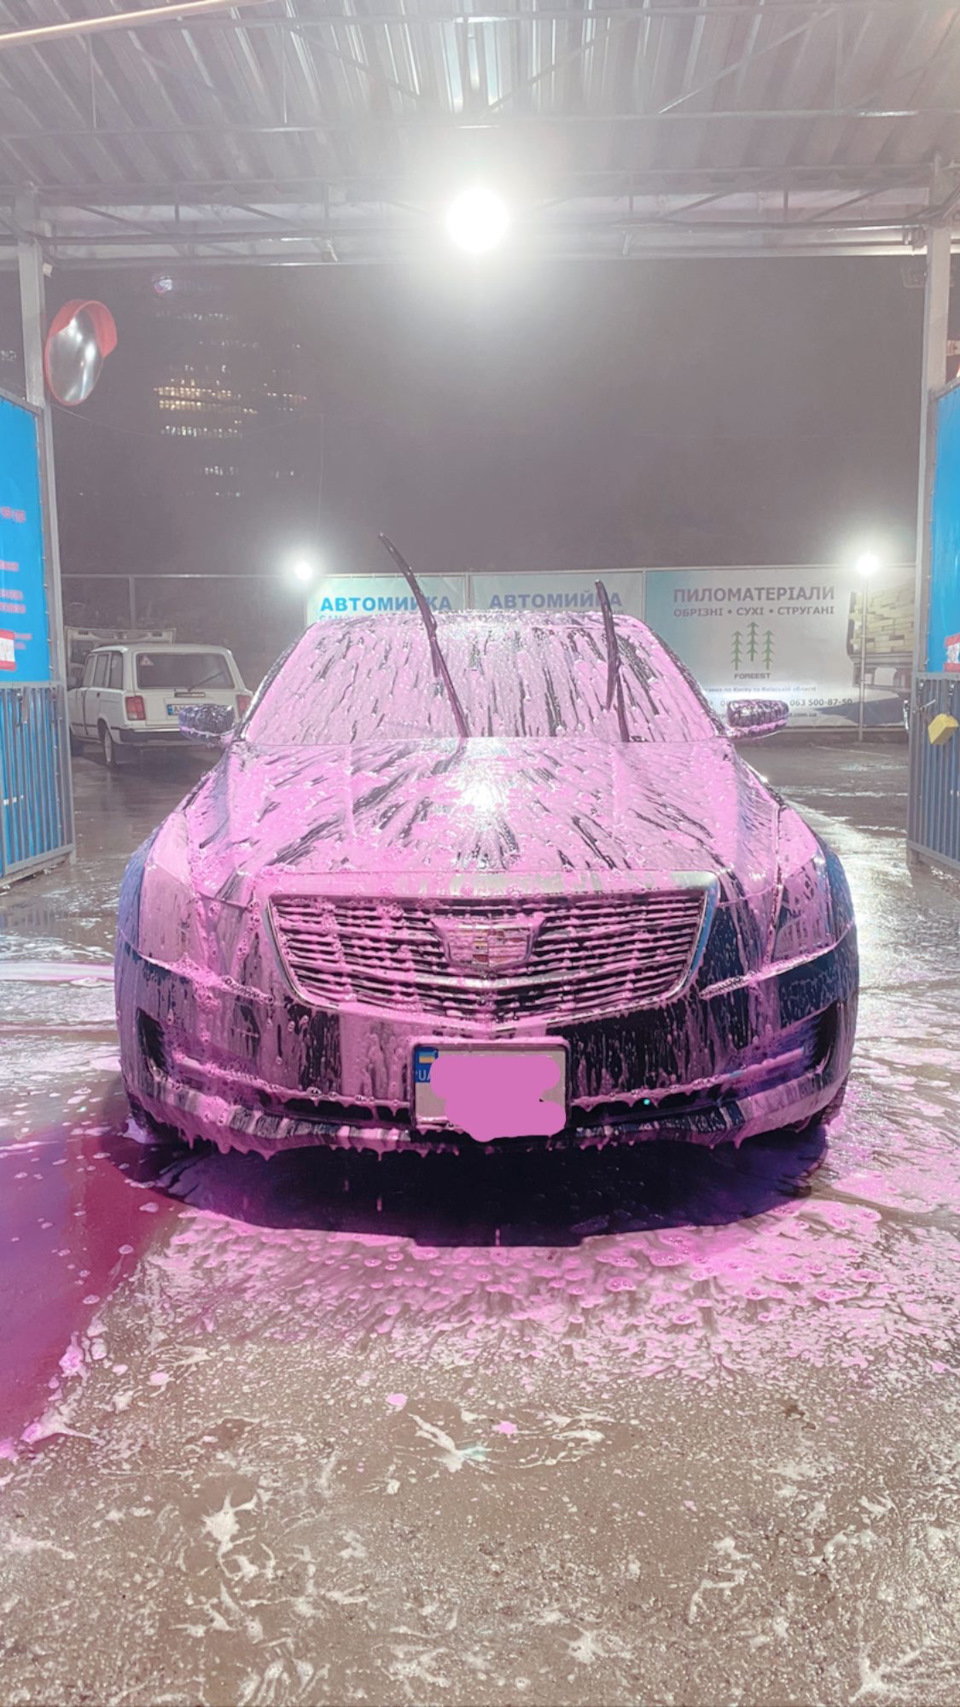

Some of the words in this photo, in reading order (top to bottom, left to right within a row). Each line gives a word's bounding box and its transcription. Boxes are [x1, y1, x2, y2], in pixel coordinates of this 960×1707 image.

[673, 587, 834, 603] ПИЛОМАТЕРІАЛИ
[673, 607, 723, 617] ОБРІЗНІ
[736, 606, 764, 616] СУХІ
[777, 605, 834, 615] СТРУГАНІ
